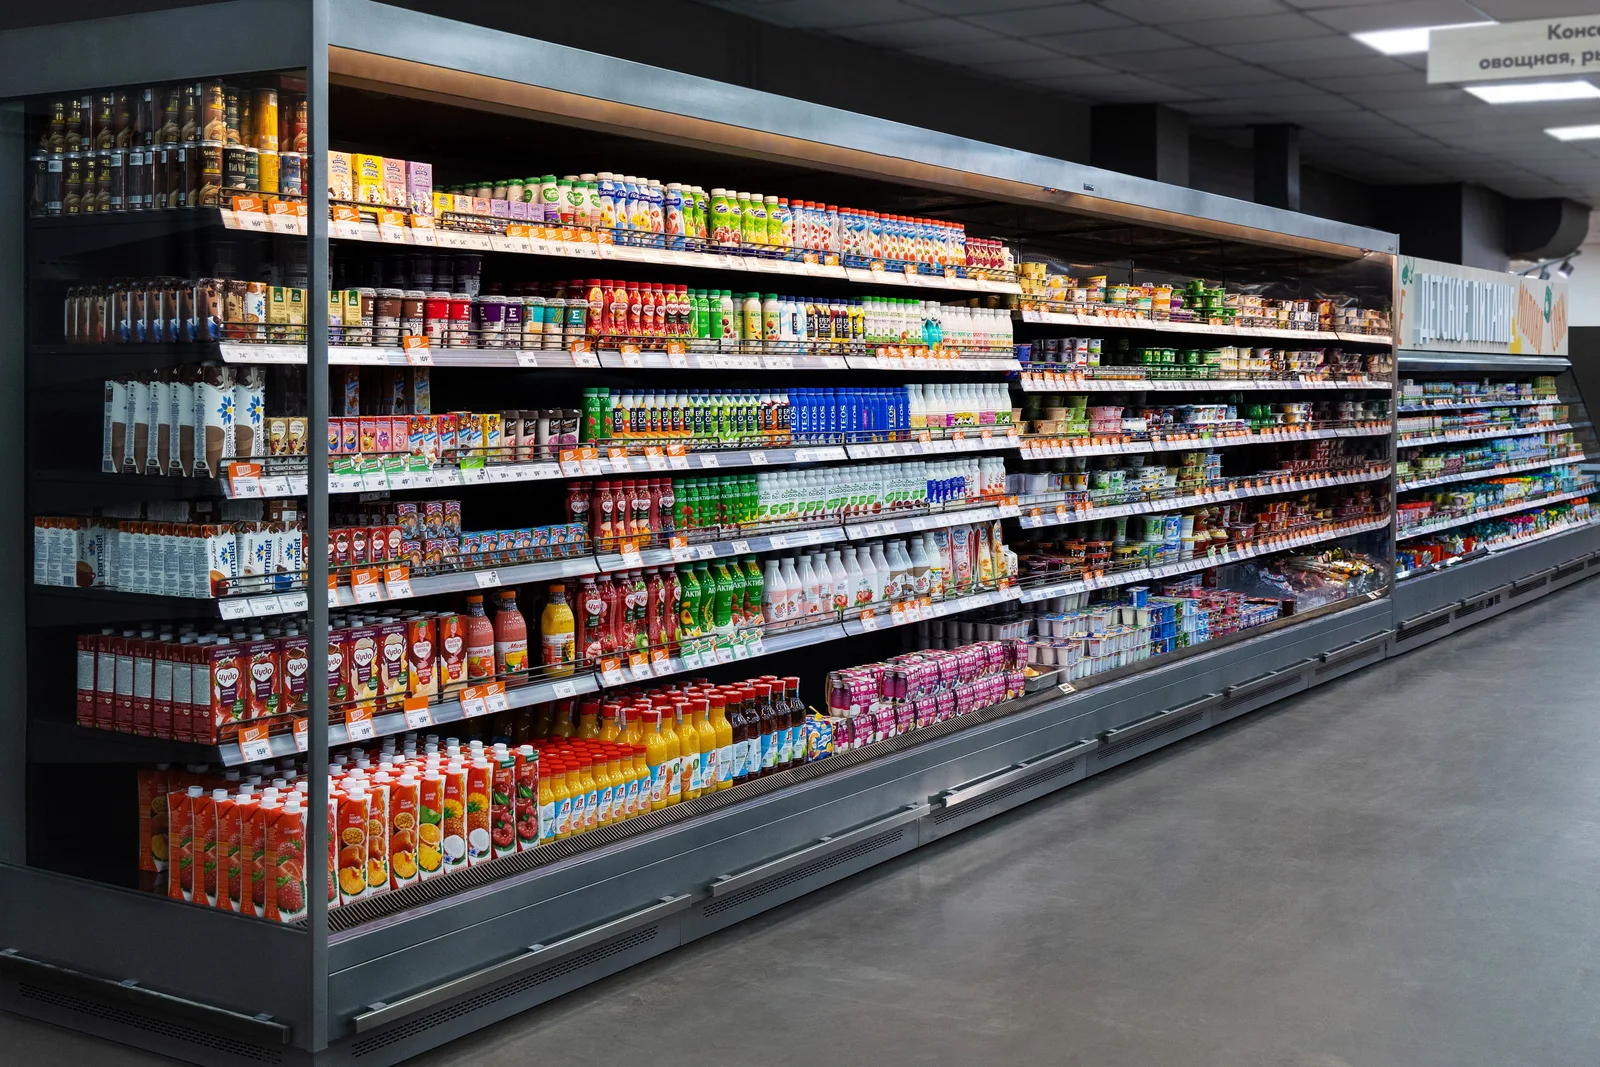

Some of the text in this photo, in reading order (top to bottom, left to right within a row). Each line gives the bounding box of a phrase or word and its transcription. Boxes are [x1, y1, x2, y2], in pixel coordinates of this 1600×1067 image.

[1479, 52, 1575, 70] овощная,
[1420, 274, 1469, 344] ДЕТСКОЕ
[1472, 281, 1514, 343] ПИТАНИЕ
[96, 534, 104, 577] parmalat
[356, 653, 372, 662] Чудо
[386, 648, 401, 657] Чудо
[254, 667, 272, 677] Чудо
[289, 662, 306, 672] Чудо
[219, 673, 237, 683] Чудо
[852, 693, 878, 702] Actimuno
[877, 720, 895, 728] Actimuno
